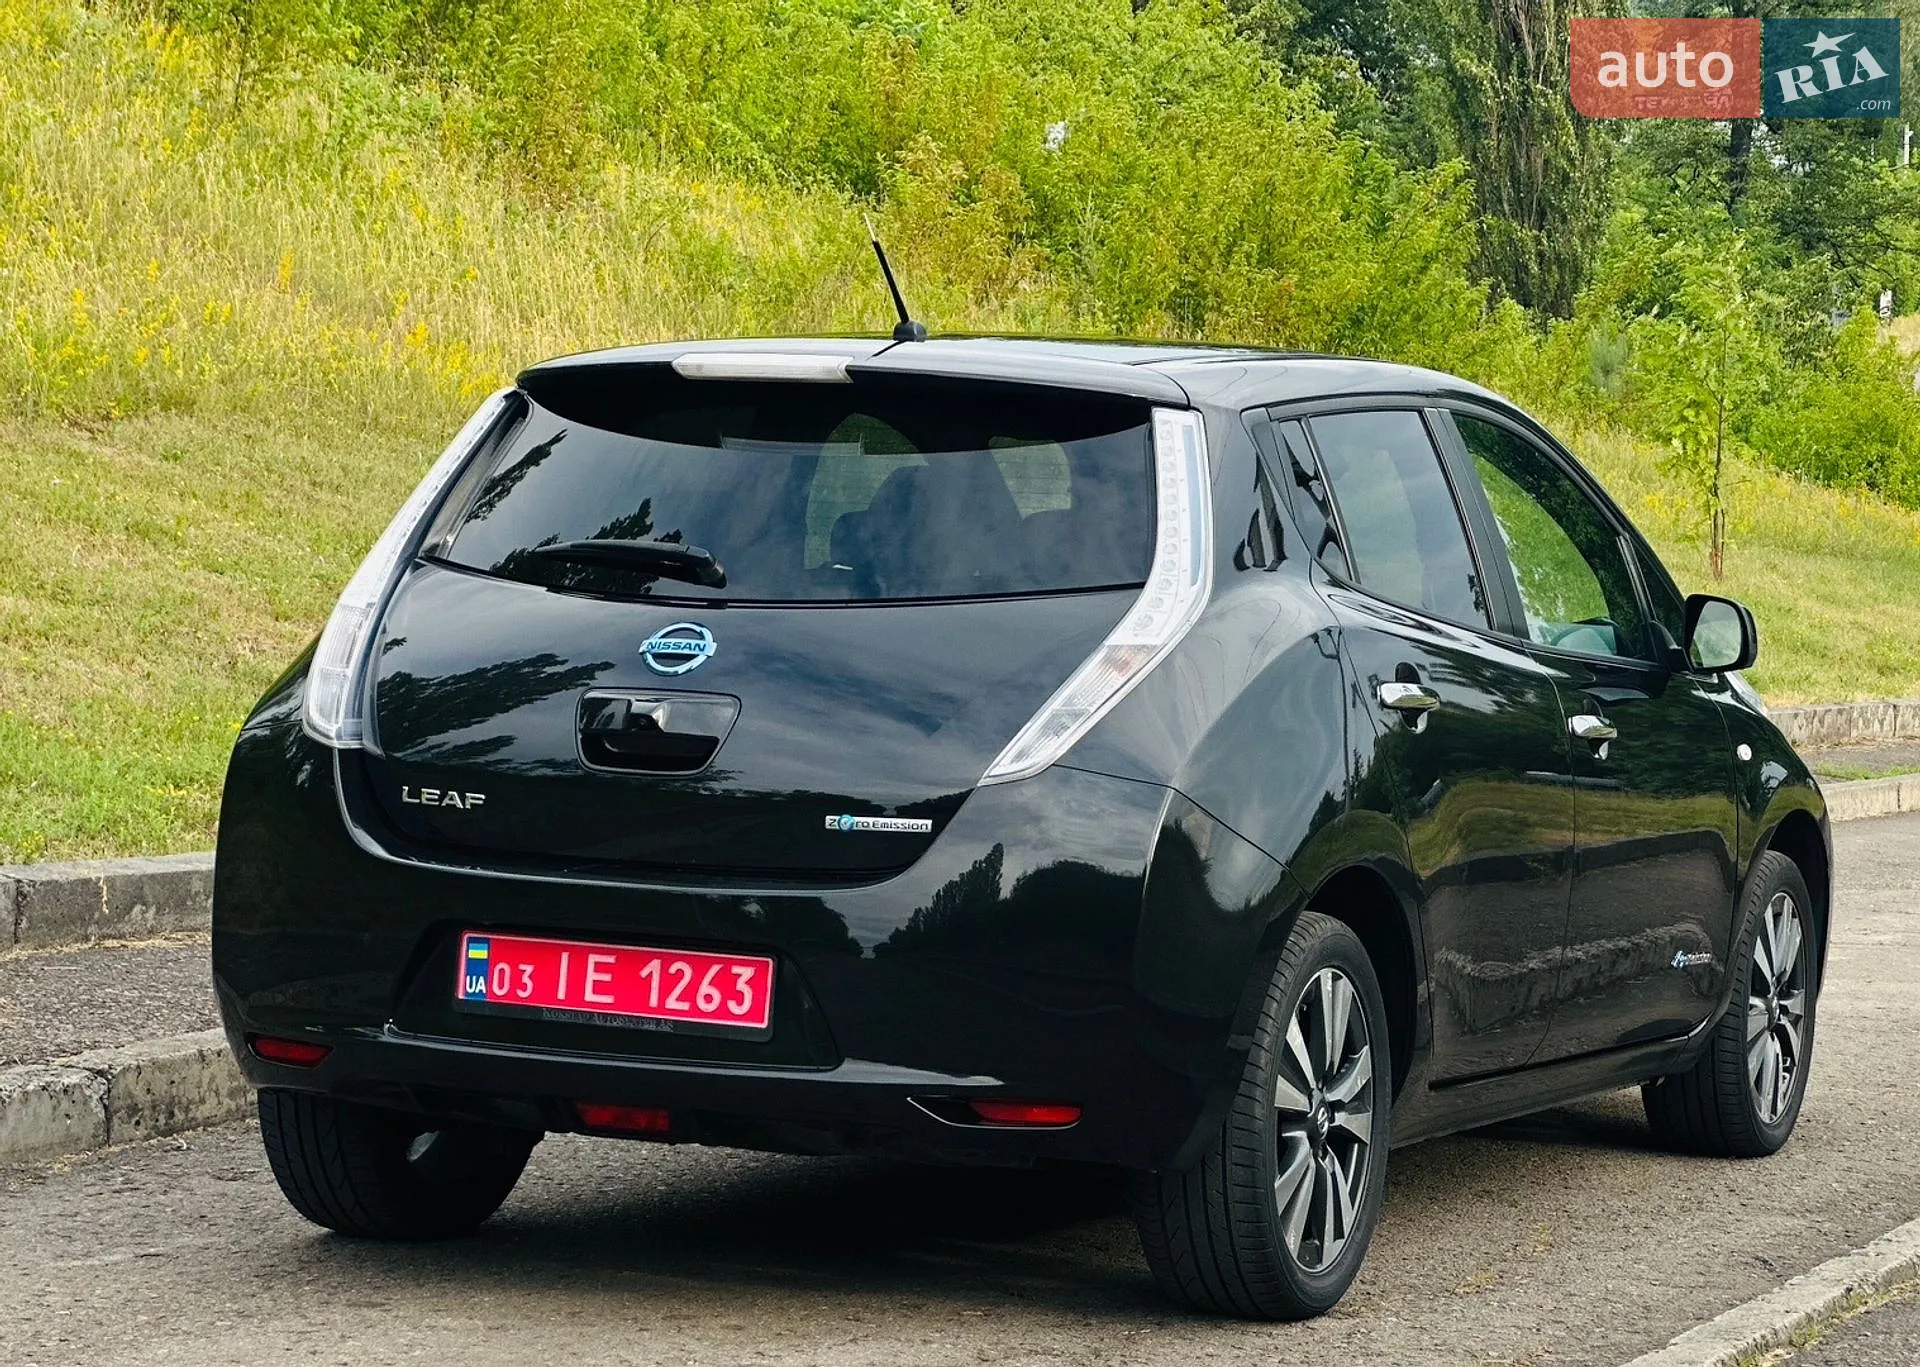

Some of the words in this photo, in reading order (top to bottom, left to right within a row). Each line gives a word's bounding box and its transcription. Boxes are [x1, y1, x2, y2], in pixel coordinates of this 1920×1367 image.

[646, 641, 707, 652] NISSAN
[402, 785, 486, 810] LEAF
[465, 975, 486, 994] UA
[492, 962, 534, 998] 03
[556, 951, 618, 1004] IE
[639, 958, 757, 1016] 1263
